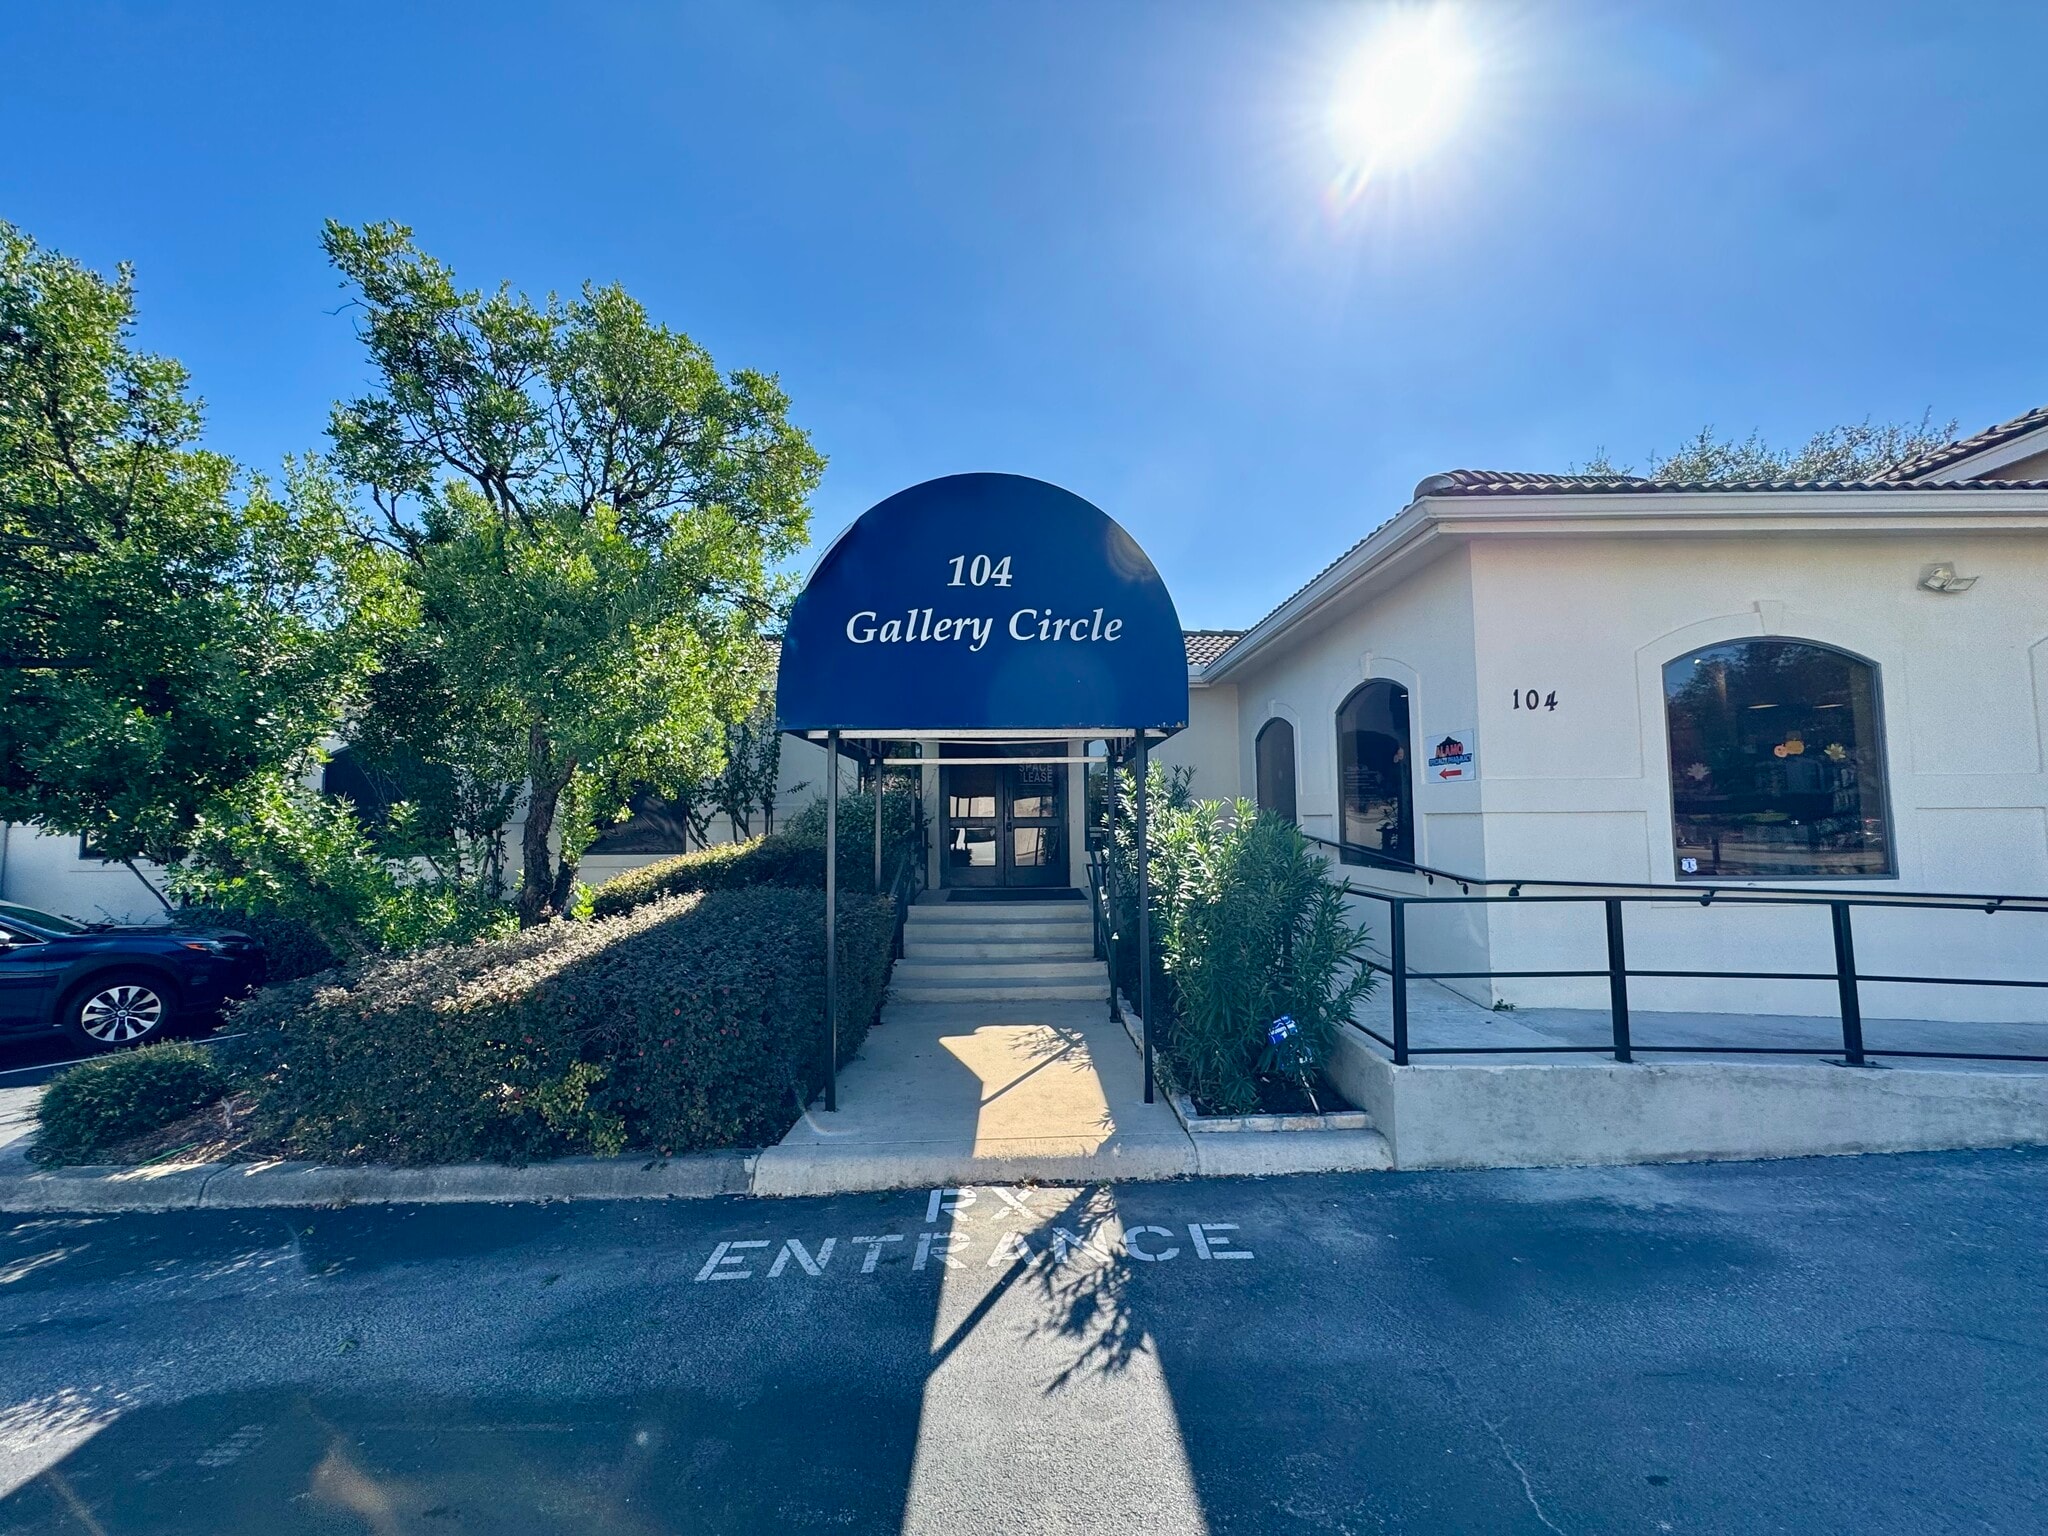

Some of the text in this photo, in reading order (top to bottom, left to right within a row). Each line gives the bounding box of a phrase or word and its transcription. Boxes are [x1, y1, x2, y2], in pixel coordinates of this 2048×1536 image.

[946, 554, 1013, 587] 104
[846, 607, 1124, 652] Gallery Circle
[1513, 689, 1559, 712] 104
[1435, 743, 1463, 757] ALAMO
[1018, 763, 1053, 772] SPACE
[1023, 772, 1053, 783] LEASE
[925, 1186, 1037, 1223] RX
[694, 1222, 1255, 1282] ENTRANCE
